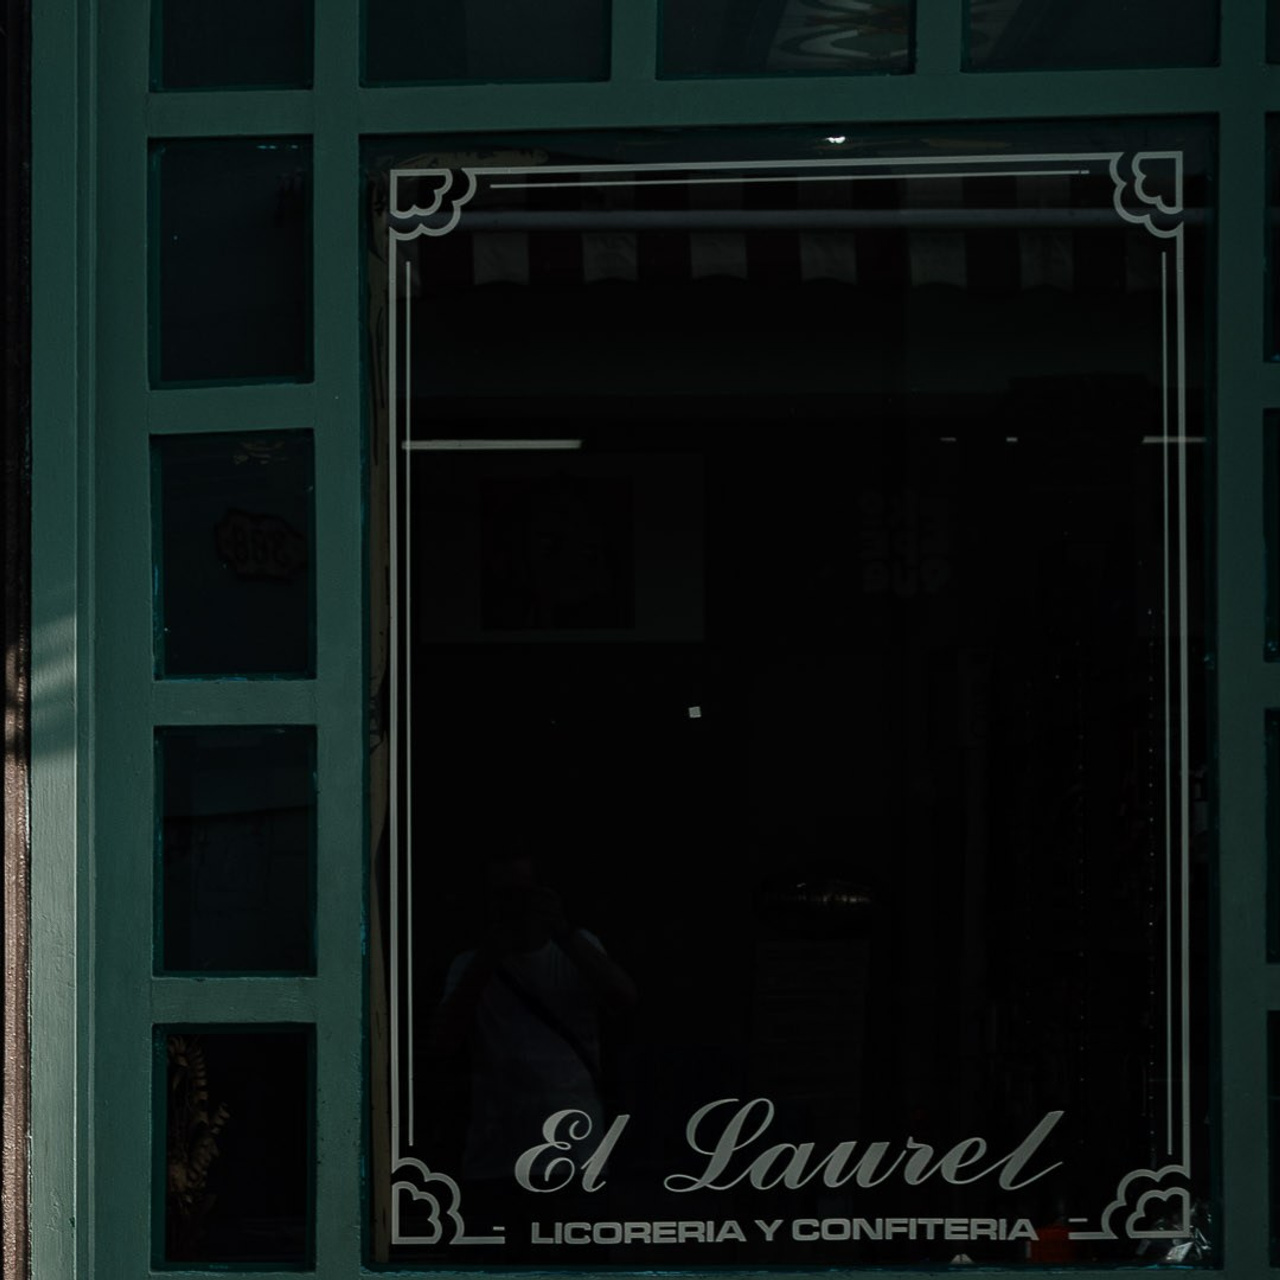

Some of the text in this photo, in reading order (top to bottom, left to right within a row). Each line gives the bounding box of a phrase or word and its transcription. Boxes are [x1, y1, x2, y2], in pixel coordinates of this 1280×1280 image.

[515, 1098, 1065, 1193] El Laurel
[531, 1217, 1039, 1244] LICORERIA Y CONFITERIA
